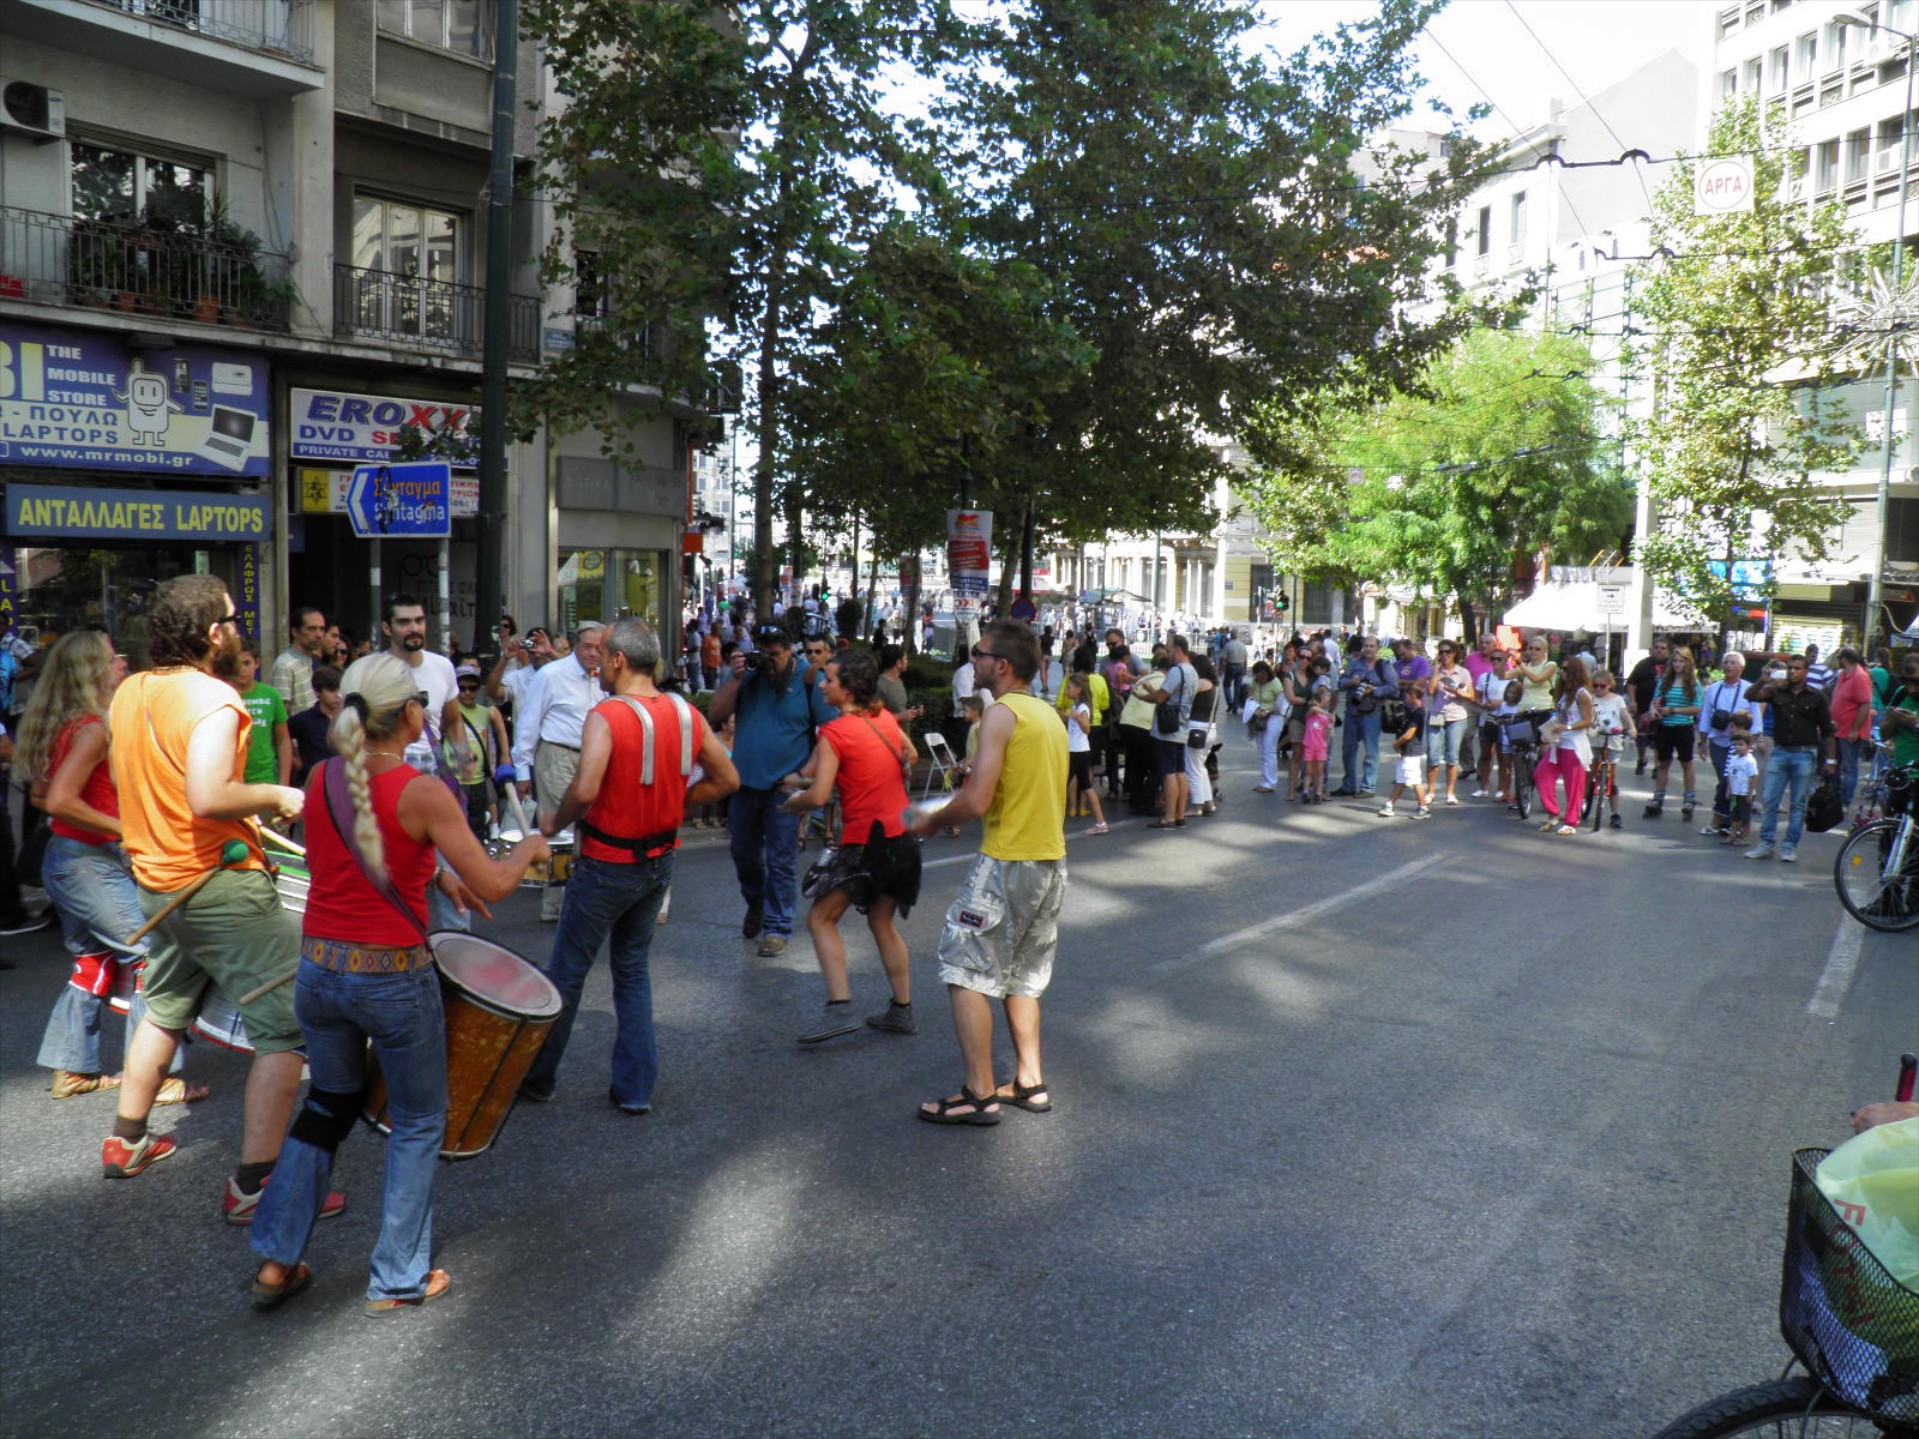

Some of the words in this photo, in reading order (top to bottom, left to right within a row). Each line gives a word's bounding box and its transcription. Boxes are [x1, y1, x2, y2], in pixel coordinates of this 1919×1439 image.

[1705, 176, 1742, 195] ΑΡΓΑ
[46, 344, 82, 360] THE
[47, 367, 116, 386] MOBILE
[47, 389, 107, 406] STORE
[30, 406, 118, 426] ΠΟΥΛΩ
[307, 395, 482, 431] EROXX
[3, 423, 118, 445] LAPTOPS
[300, 425, 355, 443] DVD
[20, 445, 193, 467] www.mrmobi.gr
[299, 445, 358, 458] PRIVATE
[18, 498, 165, 530] ΑΝΤΑΛΛΑΓΕΣ
[176, 504, 263, 533] LAPTOPS
[374, 502, 445, 524] Sntagma
